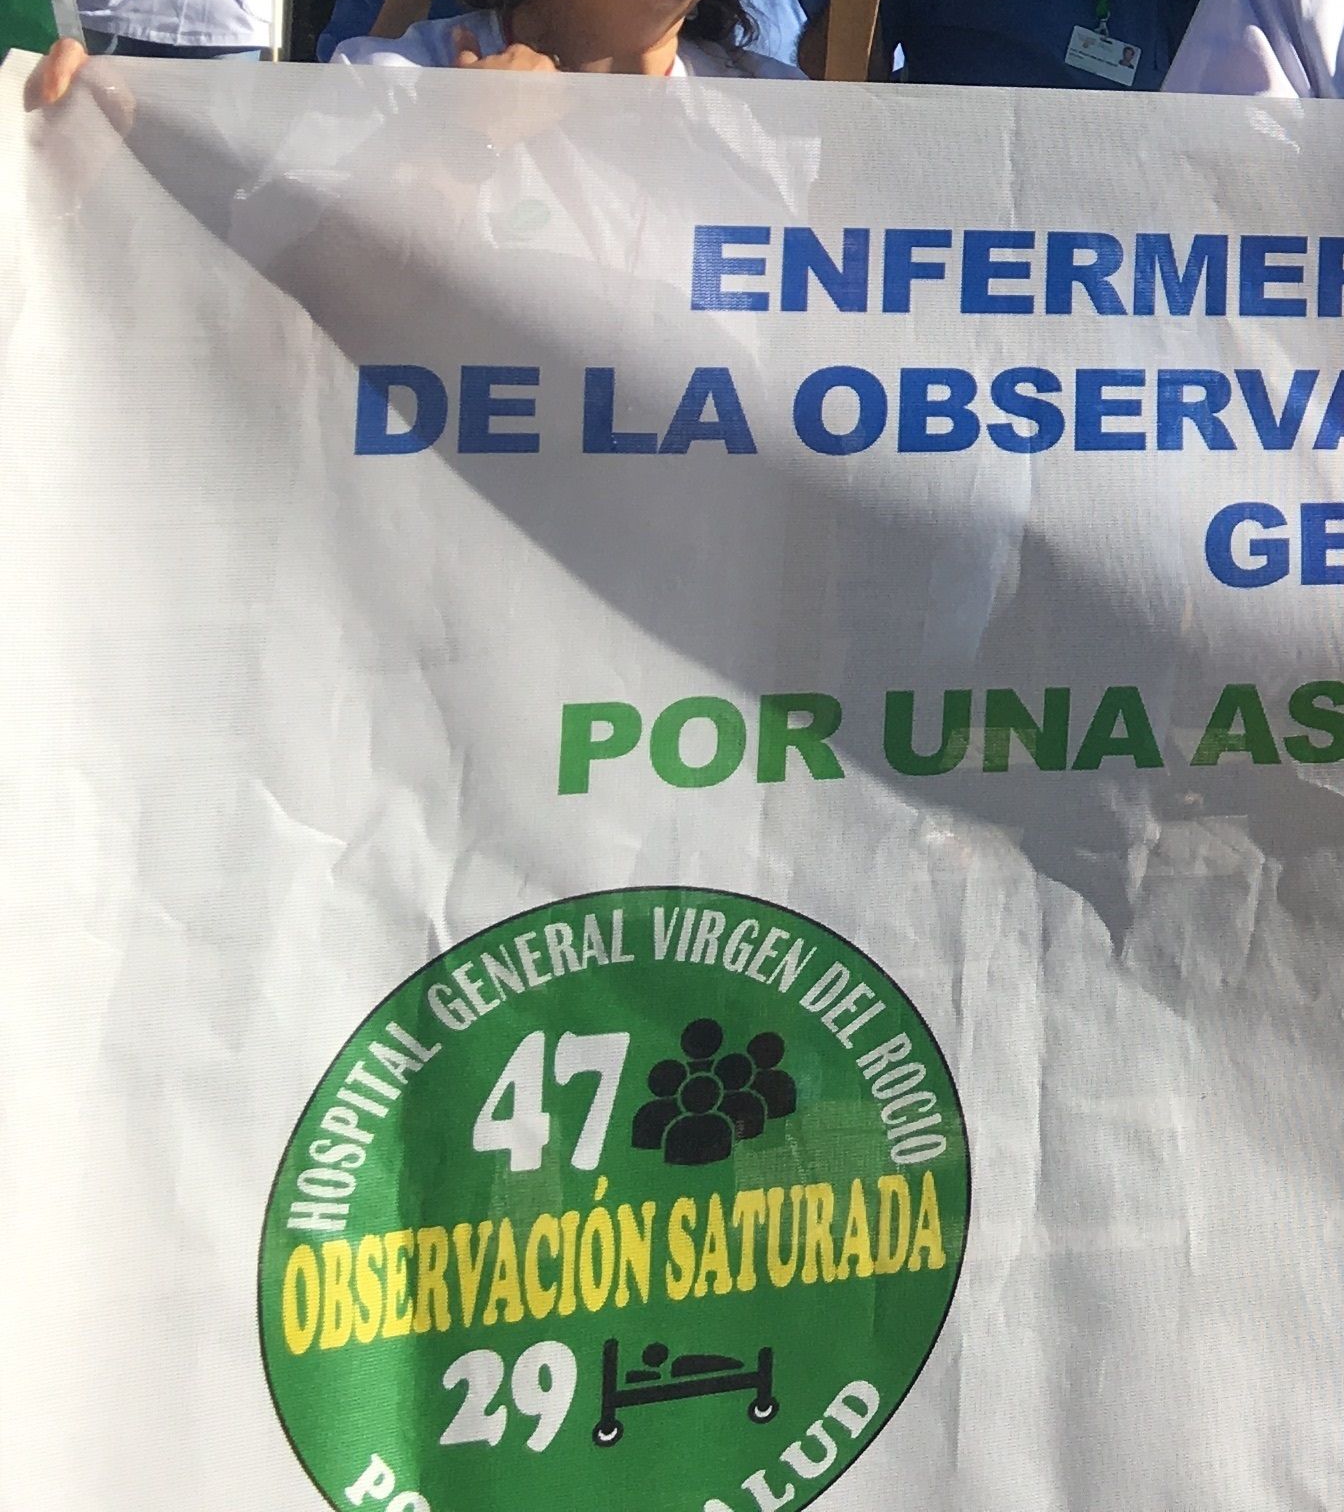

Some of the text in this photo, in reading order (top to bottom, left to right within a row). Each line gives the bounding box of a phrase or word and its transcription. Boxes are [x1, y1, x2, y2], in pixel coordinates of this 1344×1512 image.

[353, 363, 542, 456] DE
[581, 366, 758, 456] LA
[557, 691, 844, 796] POR
[881, 684, 1164, 778] UNA
[287, 906, 947, 1231] HOSPITAL GENERAL VIRGEN DEL ROCIO
[472, 1031, 631, 1172] 47
[281, 1171, 945, 1354] OBSERVACIÓN SATURADA
[439, 1340, 577, 1454] 29
